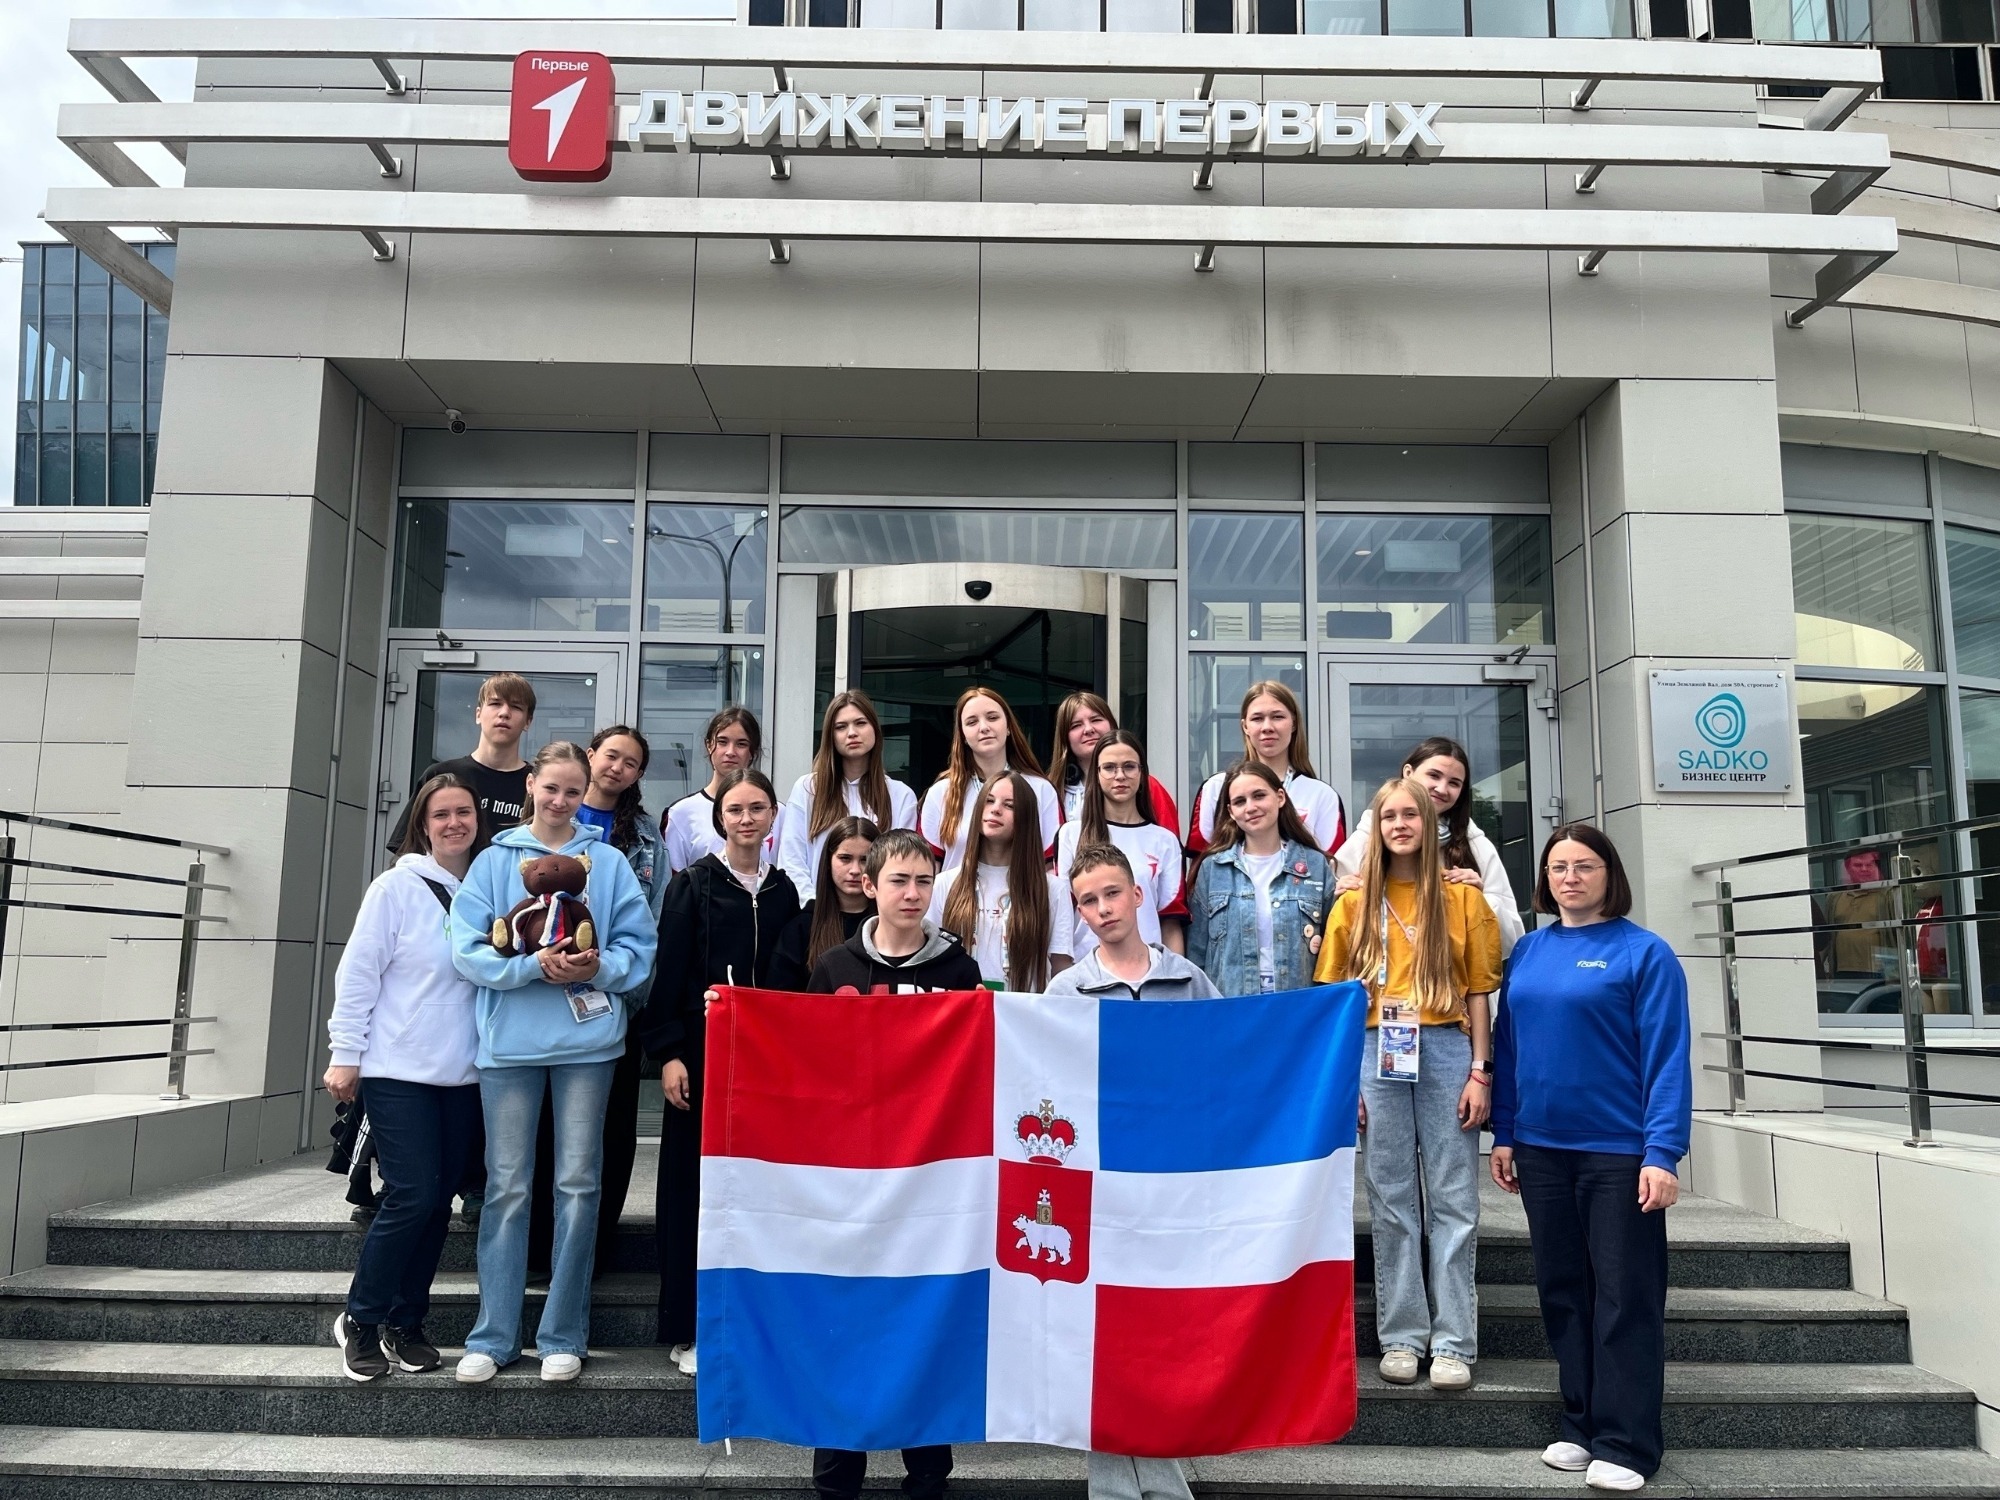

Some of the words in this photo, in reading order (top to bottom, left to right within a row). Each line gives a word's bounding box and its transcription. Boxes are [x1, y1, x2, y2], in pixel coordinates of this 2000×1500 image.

[530, 57, 590, 72] Первые
[627, 88, 1088, 152] ДВИЖЕНИЕ
[1106, 98, 1445, 156] ПЕРВЫХ
[1678, 749, 1768, 770] SADKO
[1681, 772, 1727, 781] БИЗНЕС
[1729, 773, 1767, 783] ЦЕНТР
